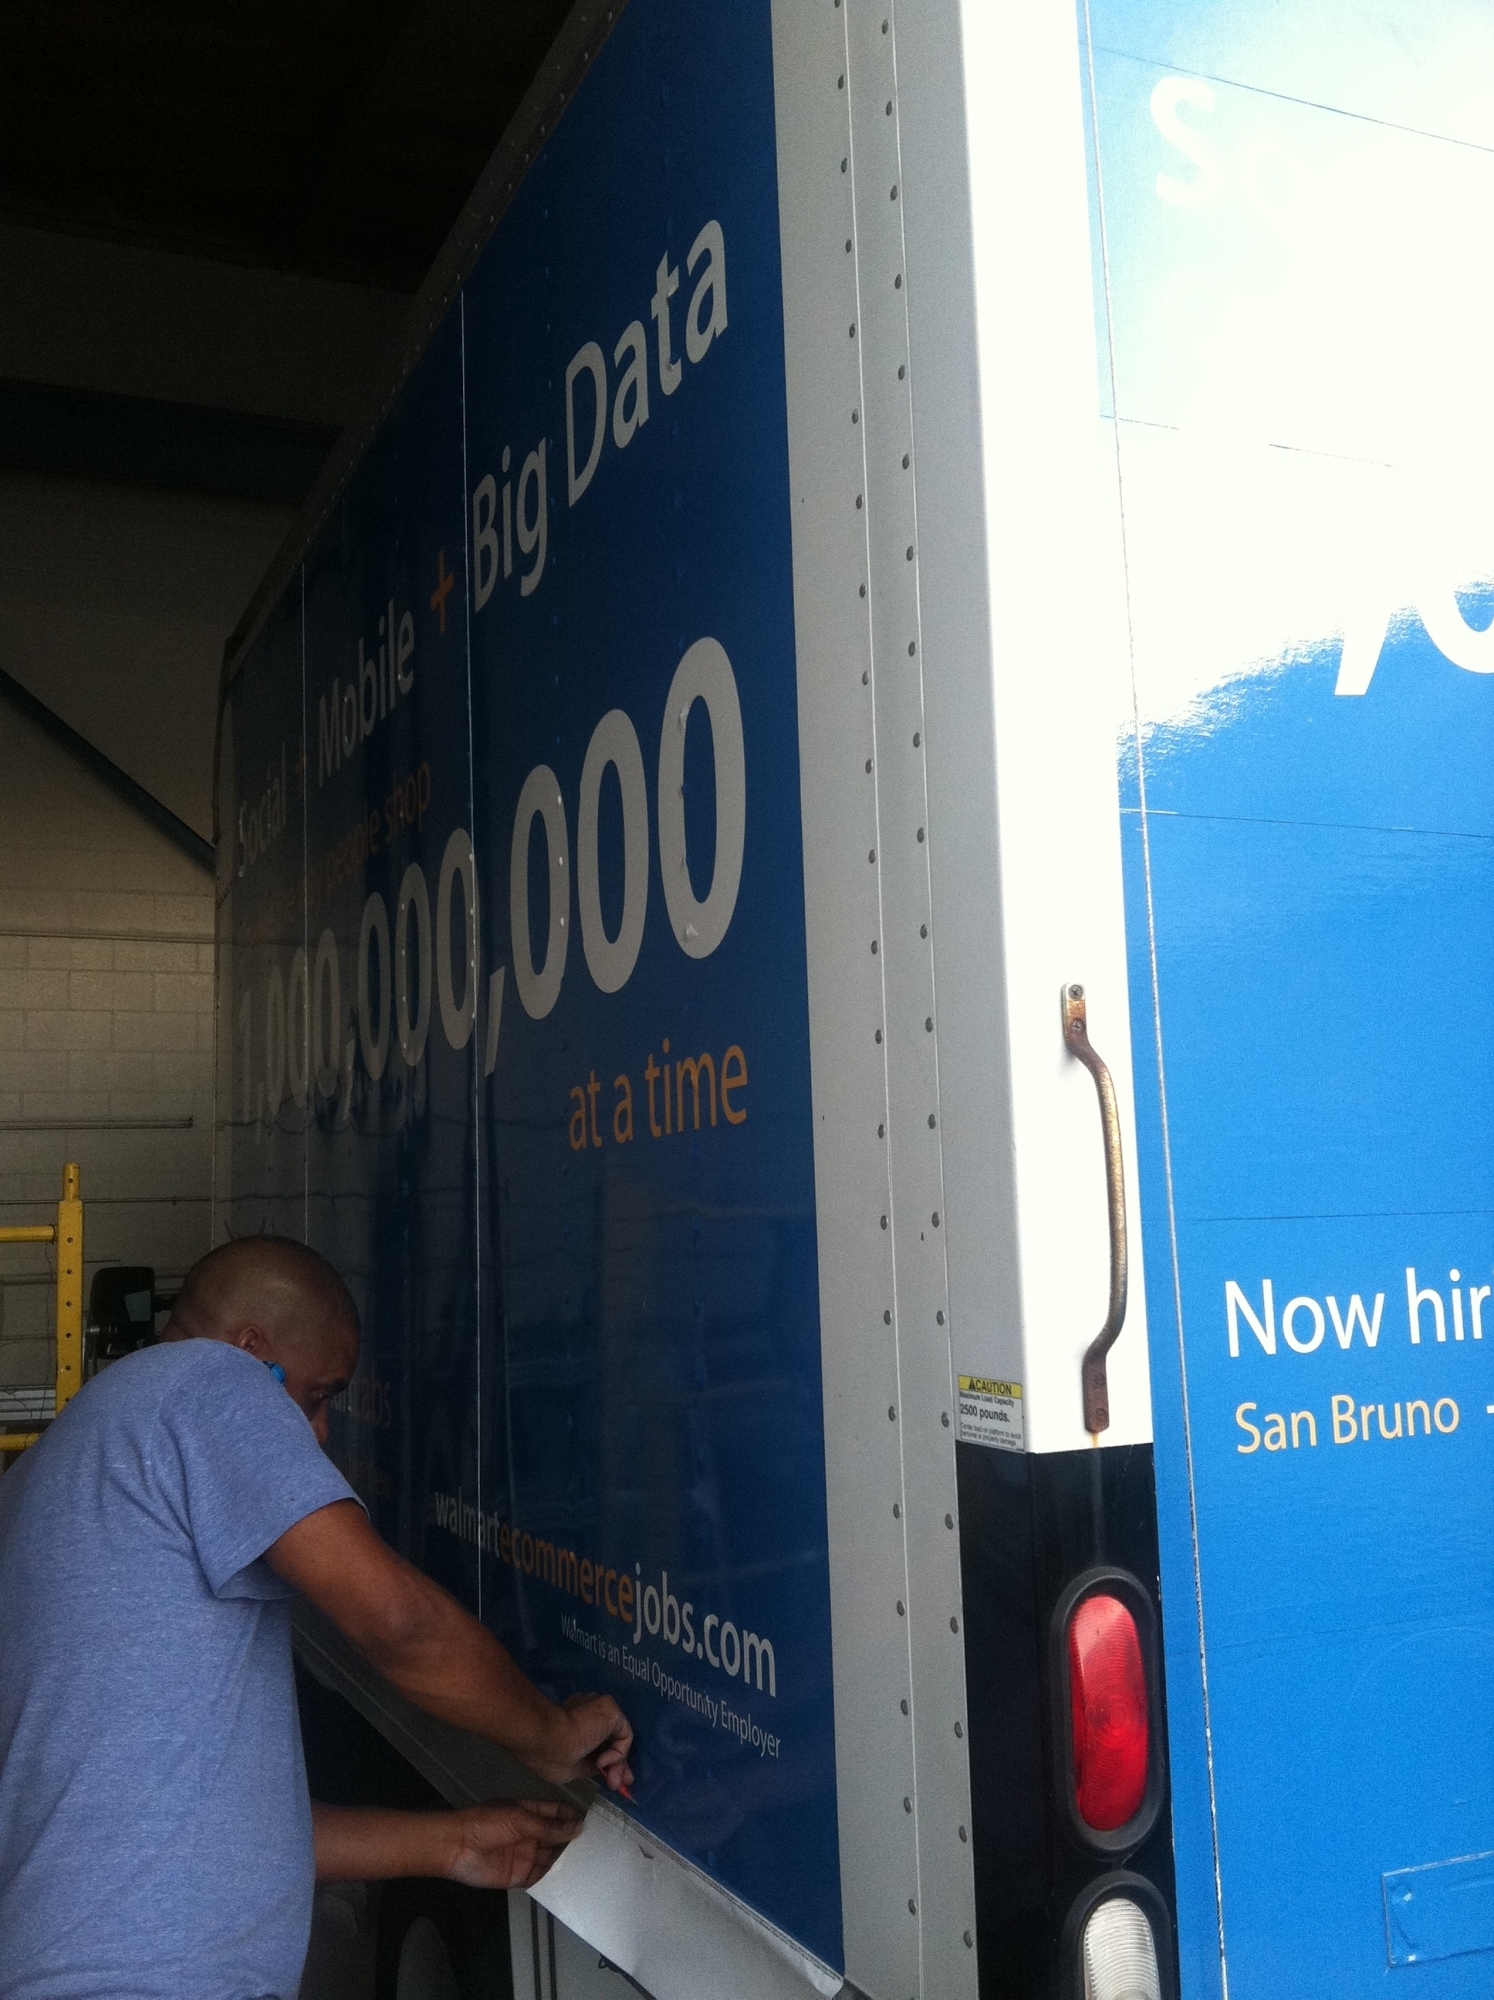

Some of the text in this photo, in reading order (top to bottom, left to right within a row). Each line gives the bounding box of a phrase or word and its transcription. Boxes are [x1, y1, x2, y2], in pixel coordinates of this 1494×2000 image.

[318, 597, 415, 788] Mobile
[472, 436, 549, 613] Big
[564, 219, 729, 508] Data
[569, 1037, 748, 1151] at a time
[1225, 1267, 1494, 1358] Now hir
[960, 1403, 977, 1417] 2500
[975, 1379, 1012, 1396] CAUTION
[1235, 1401, 1317, 1454] San
[1331, 1394, 1460, 1444] Bruno
[435, 1487, 777, 1698] walmartecommercejobs.com
[561, 1612, 781, 1759] Walmart is an Equal Opportunity Employer
